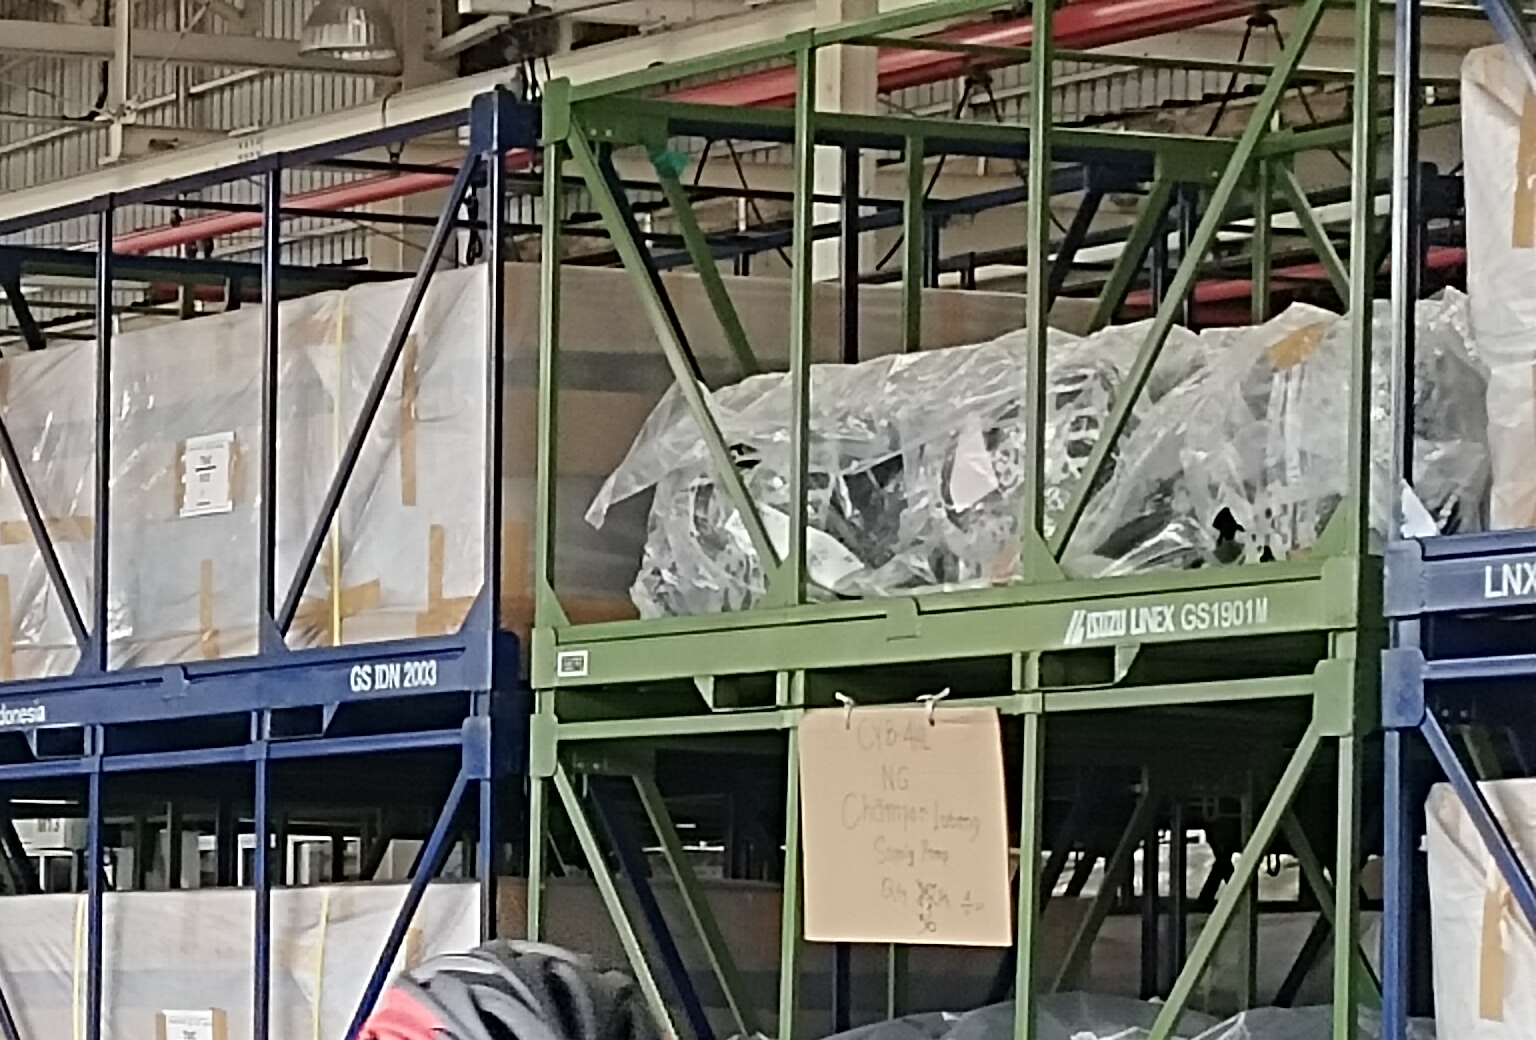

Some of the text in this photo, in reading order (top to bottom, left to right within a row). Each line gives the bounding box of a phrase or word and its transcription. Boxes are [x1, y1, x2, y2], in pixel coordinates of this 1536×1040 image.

[1086, 597, 1268, 639] ISUZU LINEX GS1901M
[350, 659, 437, 691] GS IDN 2003
[881, 763, 909, 791] NG
